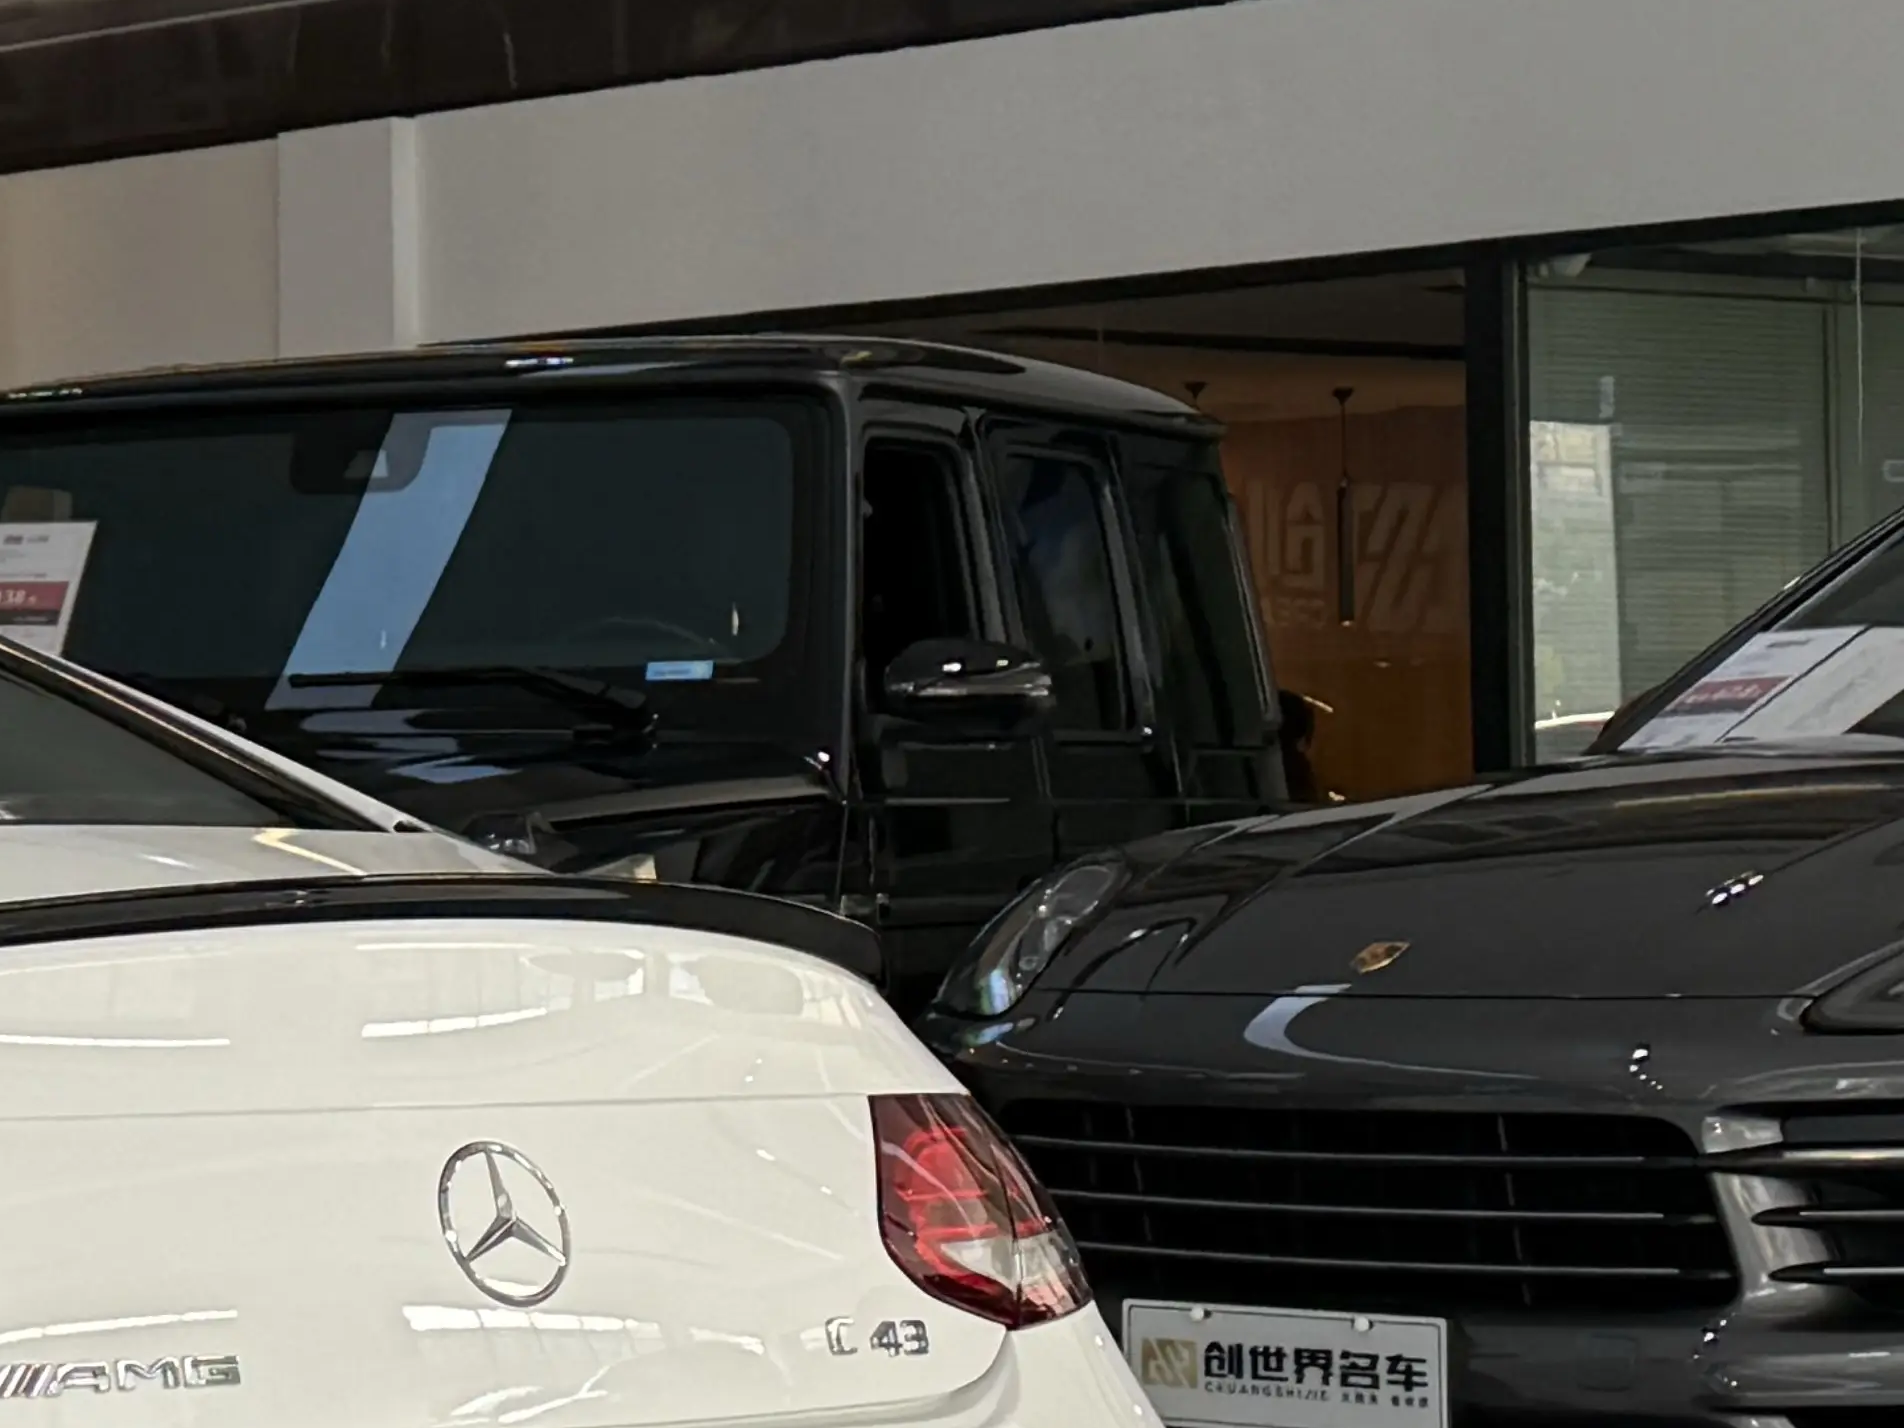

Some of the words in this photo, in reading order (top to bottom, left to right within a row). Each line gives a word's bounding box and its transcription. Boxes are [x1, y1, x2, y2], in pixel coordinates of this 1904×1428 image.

[825, 1316, 858, 1356] C
[870, 1320, 929, 1357] 43
[1204, 1340, 1429, 1393] 创世界名车
